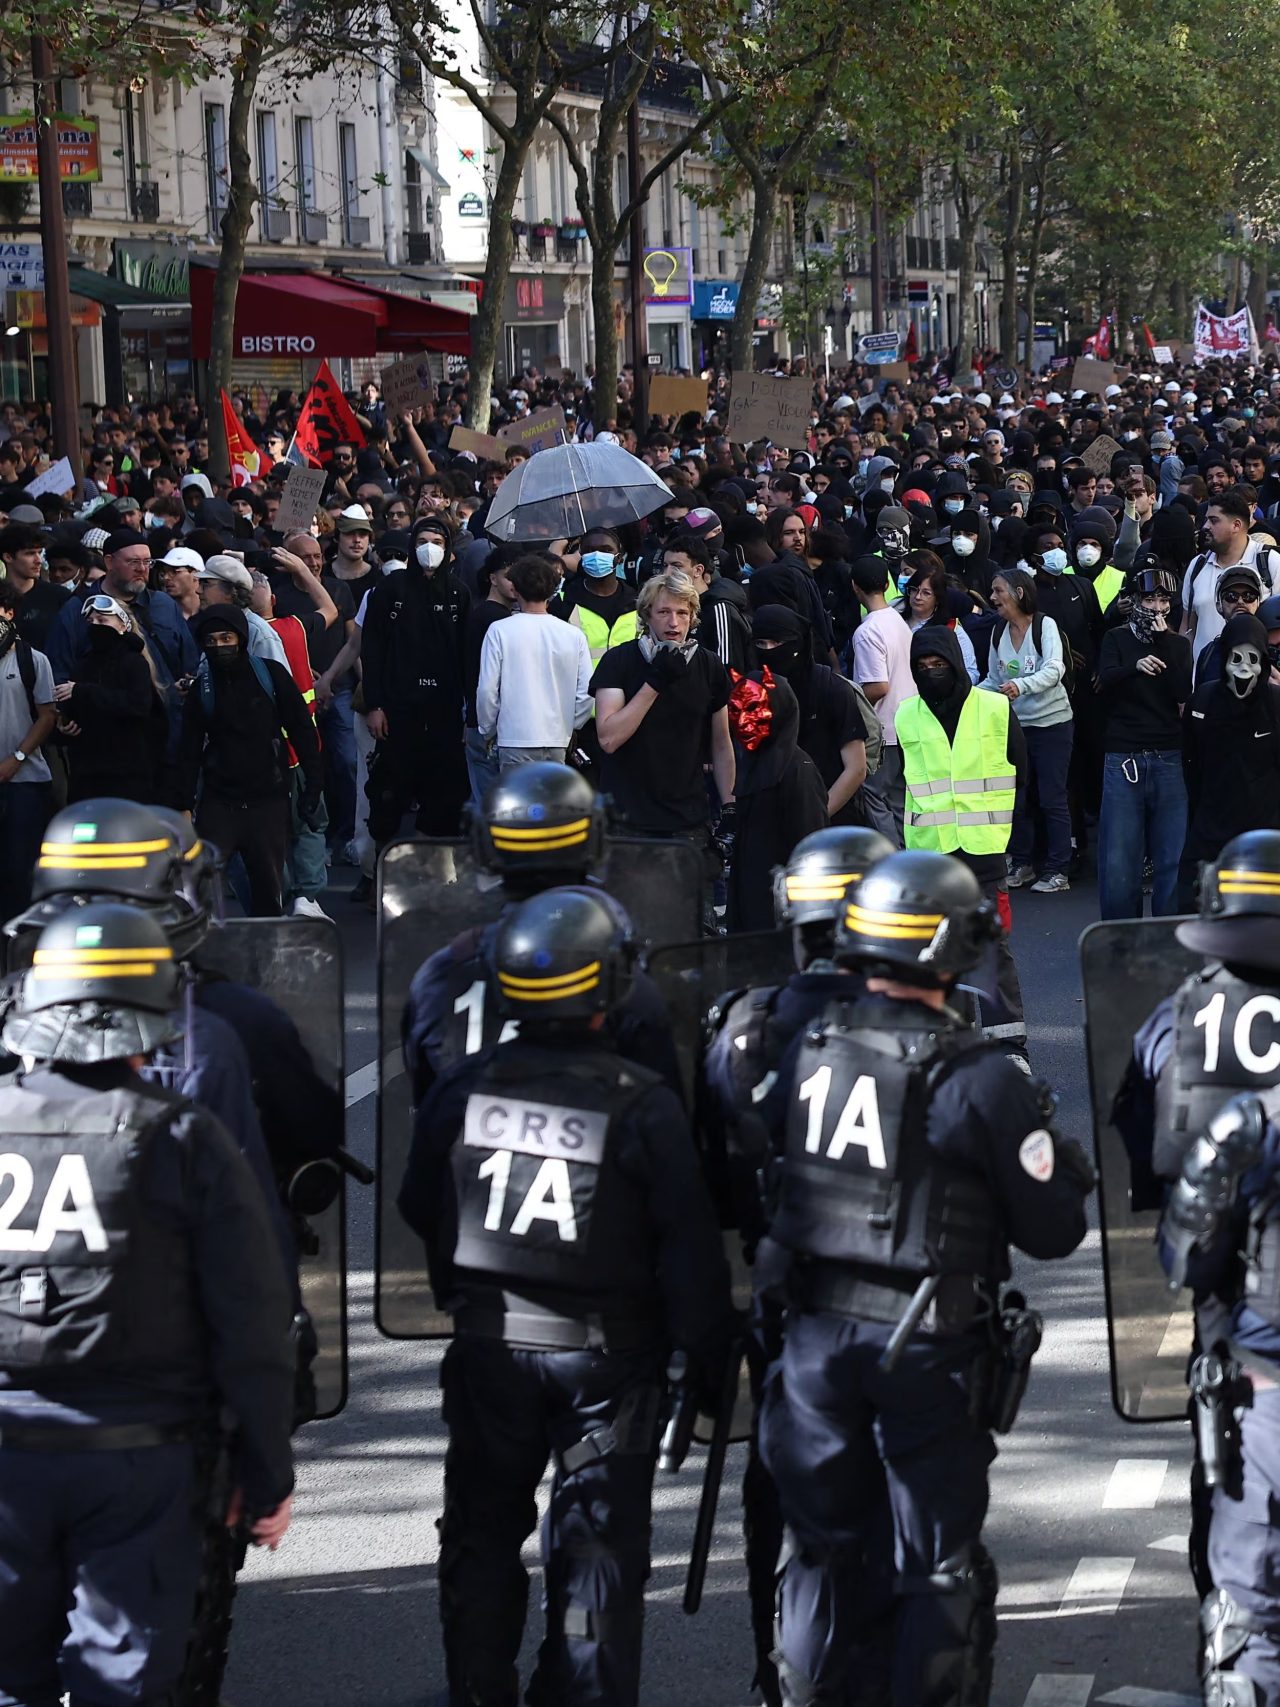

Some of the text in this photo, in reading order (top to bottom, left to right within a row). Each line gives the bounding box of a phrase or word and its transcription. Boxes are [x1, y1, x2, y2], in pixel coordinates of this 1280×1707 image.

[241, 335, 316, 353] BISTRO
[480, 1104, 586, 1150] CRS
[798, 1065, 888, 1170] 1A
[0, 1152, 109, 1253] 2A
[478, 1150, 578, 1242] 1A
